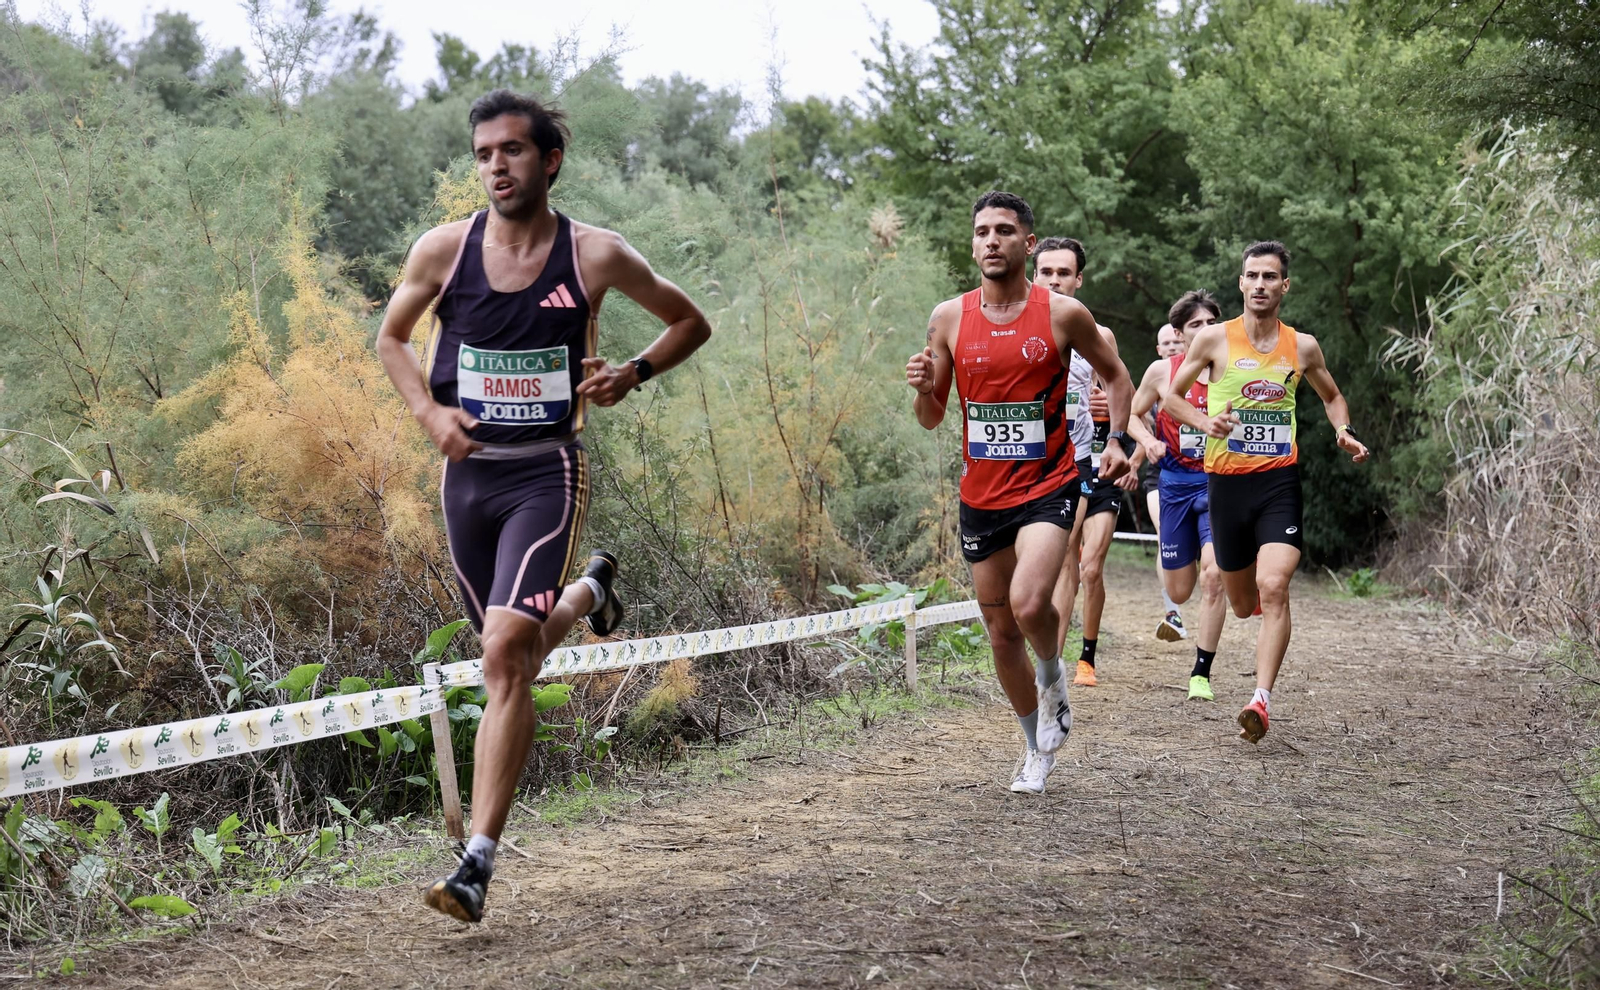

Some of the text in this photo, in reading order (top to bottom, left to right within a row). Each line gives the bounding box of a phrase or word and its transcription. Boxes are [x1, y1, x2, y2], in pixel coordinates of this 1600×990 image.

[479, 355, 546, 371] ITÁLICA
[484, 378, 542, 398] RAMOS
[1246, 386, 1283, 397] Serrano
[480, 403, 548, 420] Joma
[980, 406, 1027, 419] ITÁLICA
[1242, 412, 1281, 423] ITÁLICA
[984, 424, 1025, 442] 935
[1243, 426, 1275, 442] 831
[985, 444, 1027, 457] Joma
[1242, 442, 1277, 454] Joma
